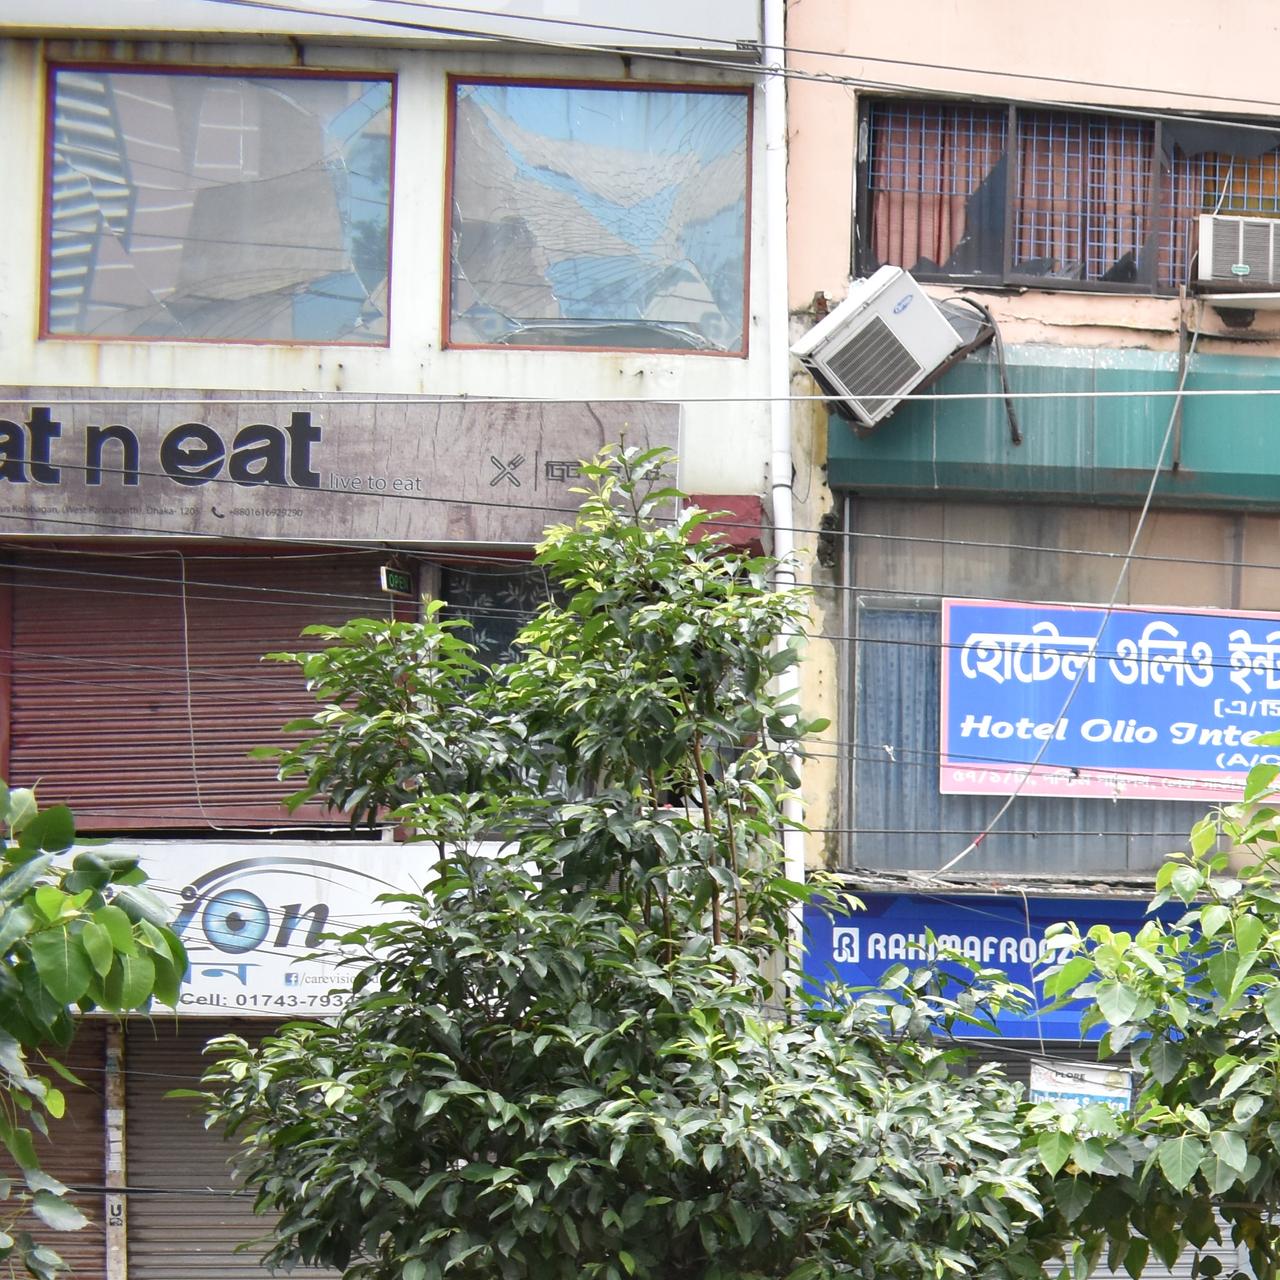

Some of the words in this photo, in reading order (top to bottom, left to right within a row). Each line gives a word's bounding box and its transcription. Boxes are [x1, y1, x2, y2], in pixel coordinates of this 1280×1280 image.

[85, 424, 140, 487] n
[159, 411, 323, 489] eat
[329, 473, 362, 490] live
[367, 475, 387, 491] to
[392, 476, 422, 492] eat
[960, 620, 1098, 684] হোটেল
[1109, 620, 1215, 688] ওলিও
[960, 714, 1068, 742] Hotel
[1080, 719, 1158, 744] Olio
[179, 992, 228, 1007] Cell:
[236, 994, 344, 1008] 01743-793
